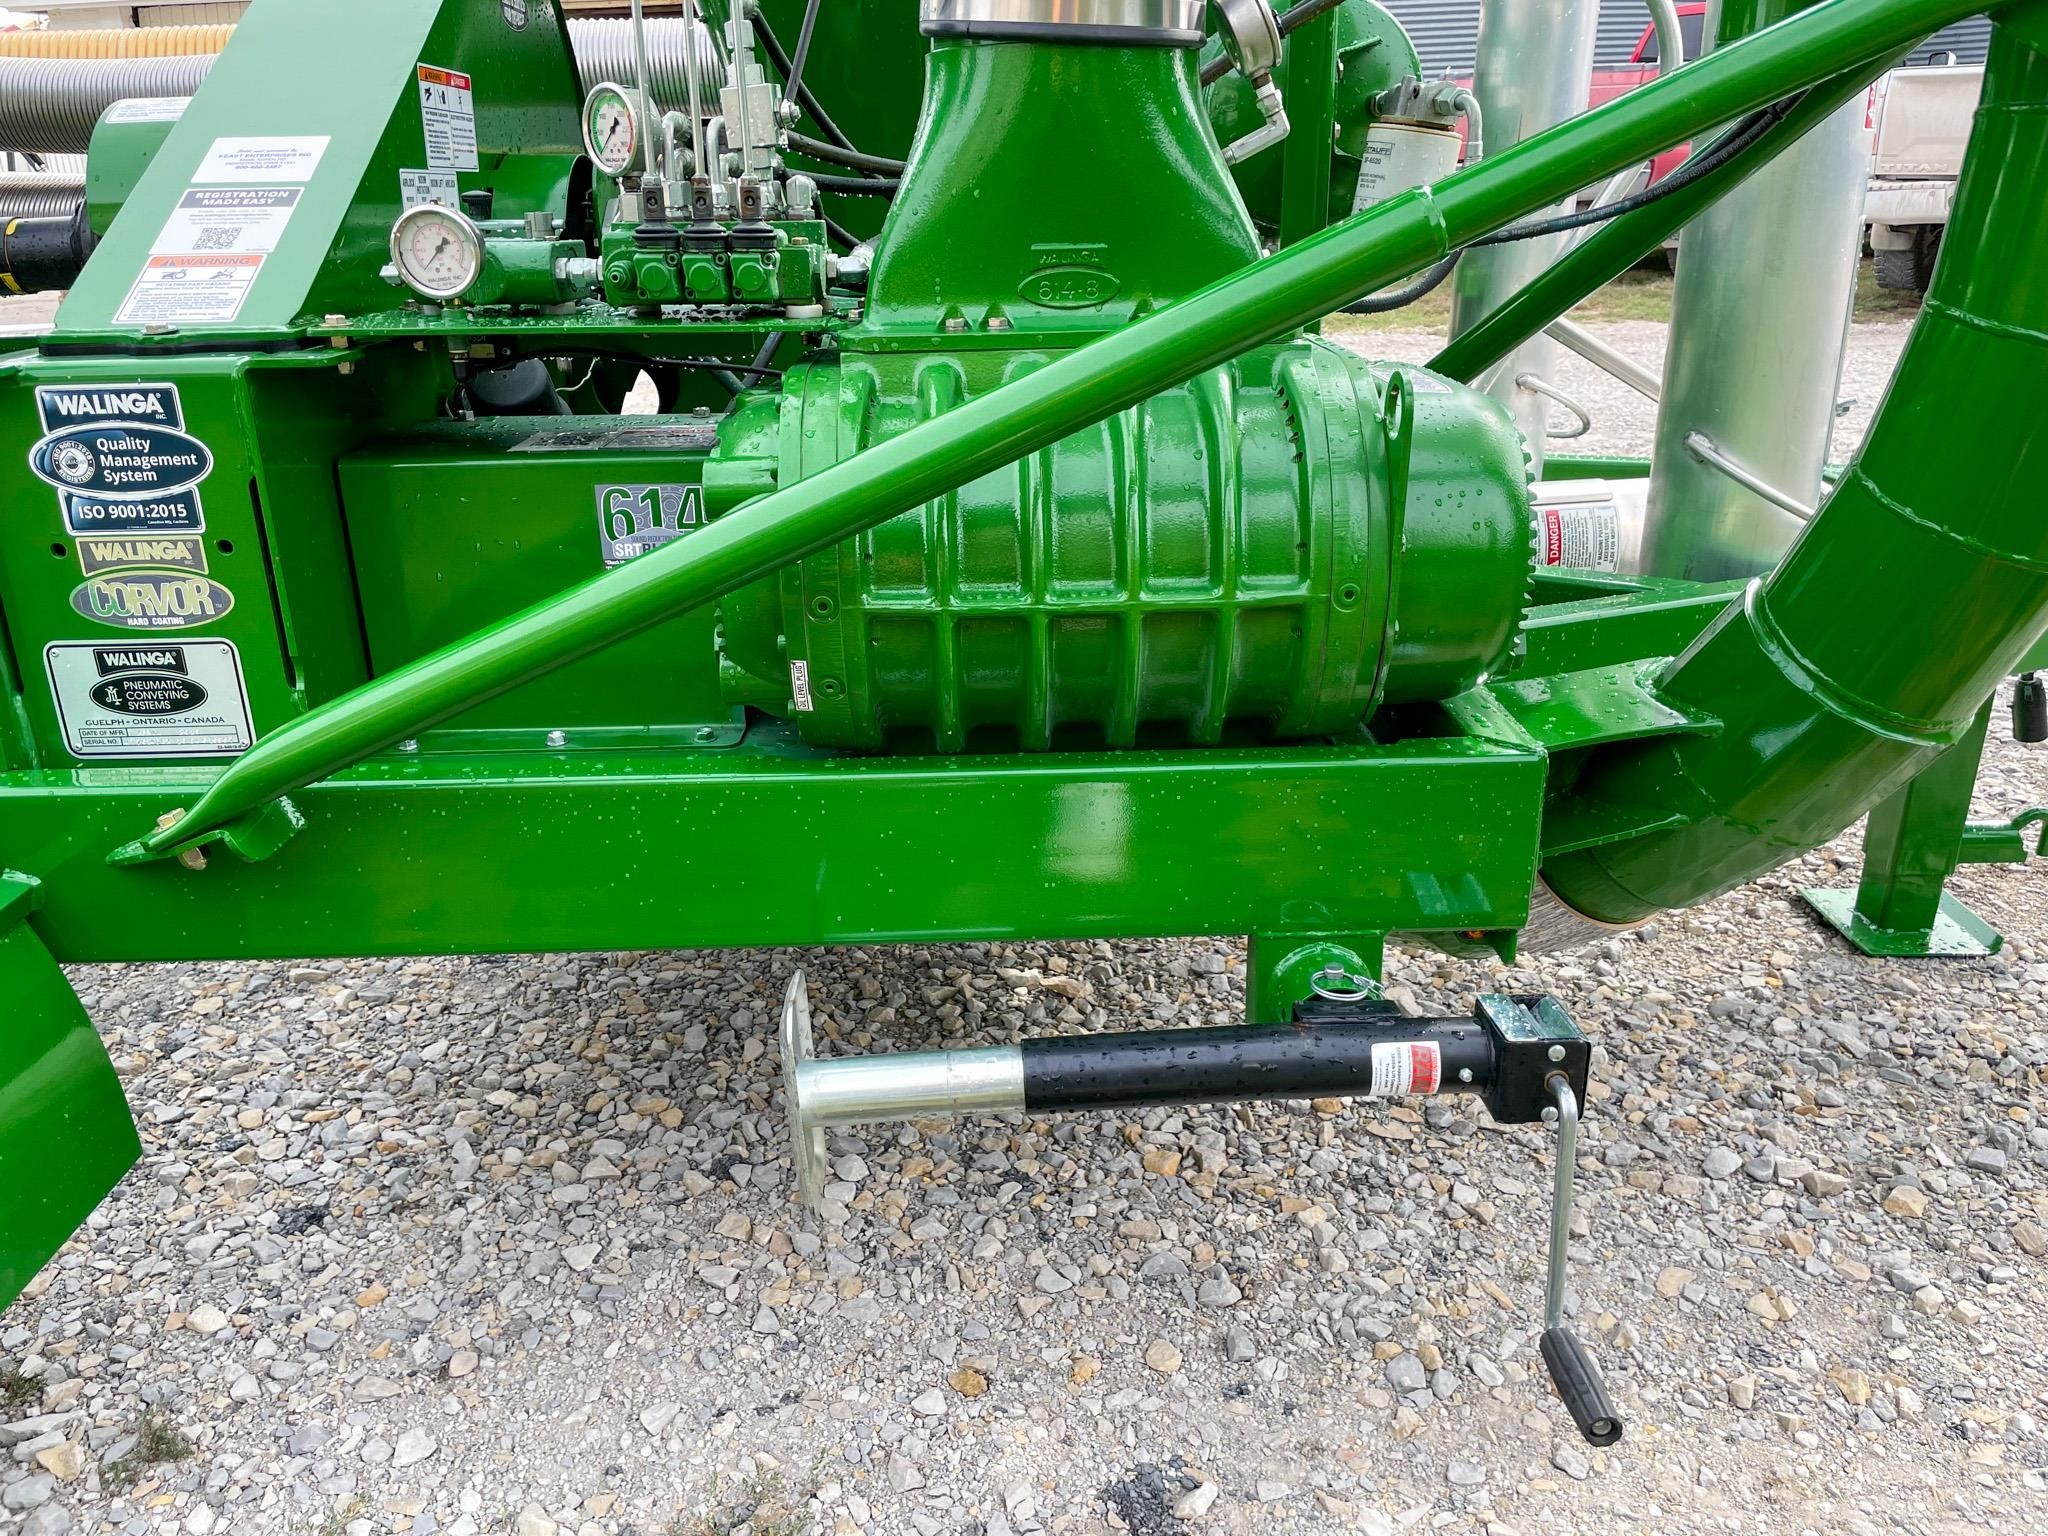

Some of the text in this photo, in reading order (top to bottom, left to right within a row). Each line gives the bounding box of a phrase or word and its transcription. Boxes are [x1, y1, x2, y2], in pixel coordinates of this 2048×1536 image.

[1880, 163, 1949, 172] TITAN
[202, 198, 239, 206] MADE
[1039, 280, 1099, 300] 614-8
[96, 437, 151, 453] Quality
[100, 454, 198, 469] Management
[103, 469, 157, 485] System
[78, 503, 187, 519] ISO 9001:2015
[601, 486, 709, 543] 614
[1547, 515, 1559, 558] DANGER
[88, 578, 215, 617] CORVOR
[127, 616, 185, 625] HARD COATING
[795, 665, 804, 681] PLUG
[123, 680, 183, 690] PNEUMATIC
[796, 682, 806, 699] LEVEL
[126, 690, 190, 700] CONVEYING
[128, 700, 171, 710] SYSTEMS
[85, 716, 225, 726] GUELPH ONTARIO CANADA
